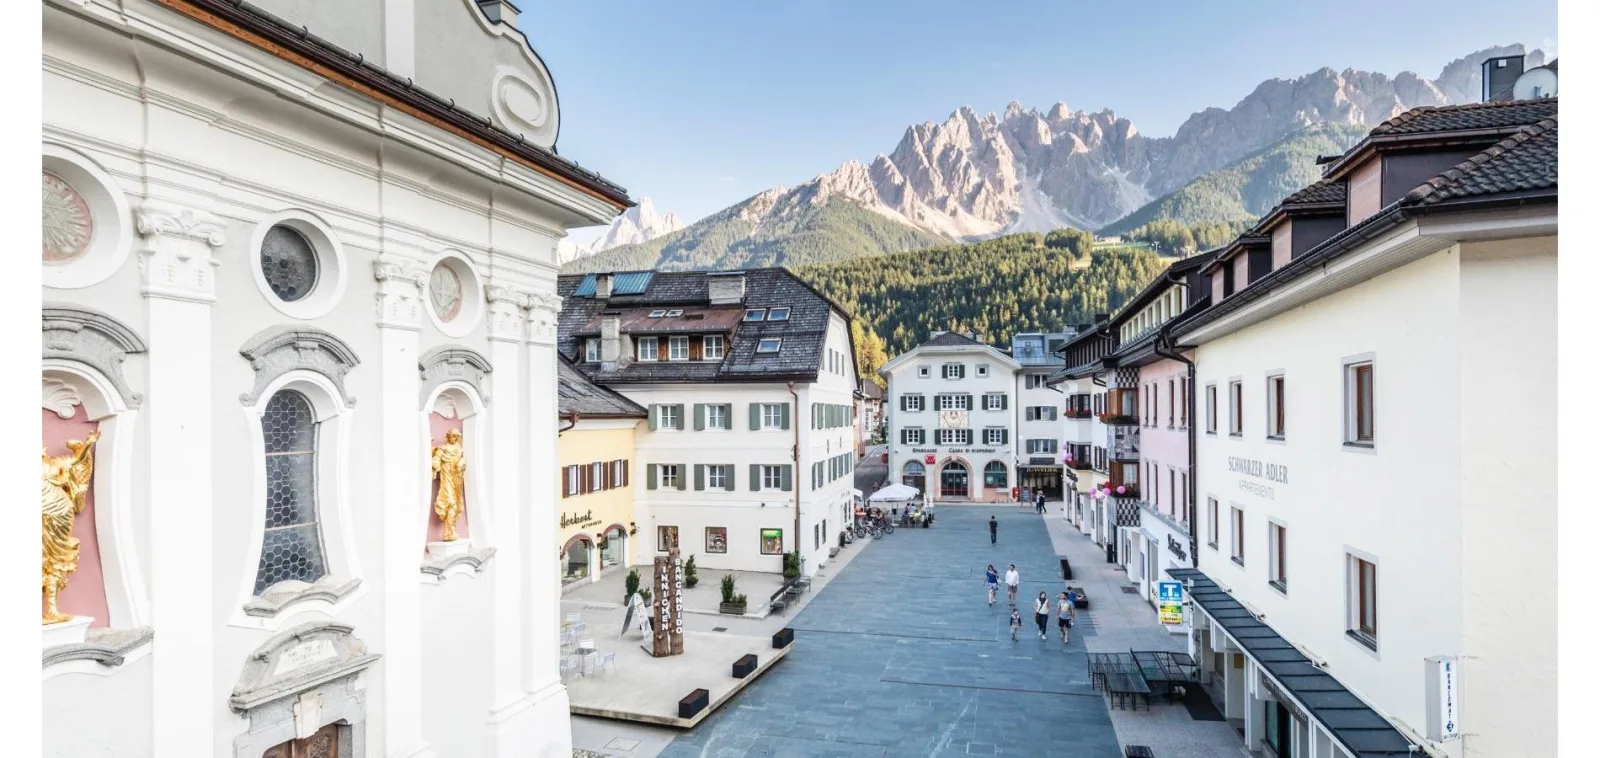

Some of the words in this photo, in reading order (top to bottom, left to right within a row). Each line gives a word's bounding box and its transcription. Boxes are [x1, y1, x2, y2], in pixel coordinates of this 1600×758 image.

[1228, 456, 1263, 478] SCHWARZER
[1265, 463, 1288, 484] ADLER
[560, 509, 593, 529] Herbert
[661, 565, 669, 631] INNICHEN
